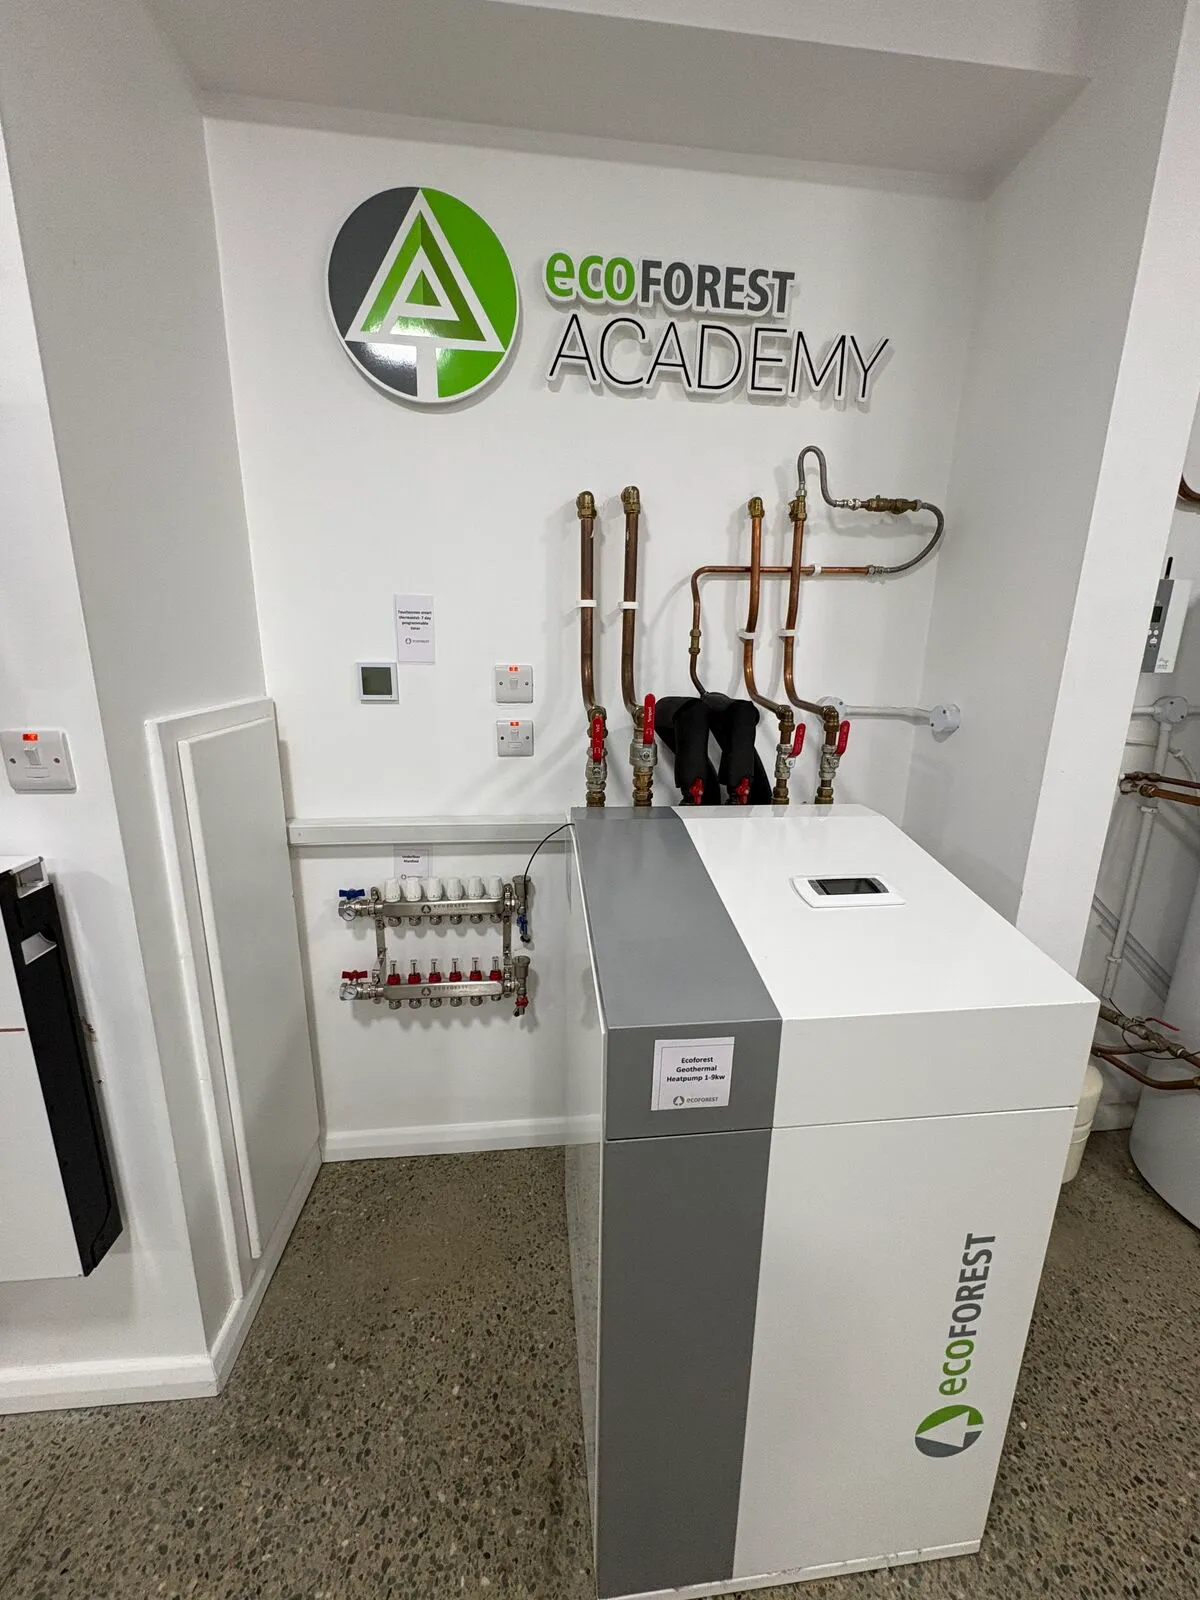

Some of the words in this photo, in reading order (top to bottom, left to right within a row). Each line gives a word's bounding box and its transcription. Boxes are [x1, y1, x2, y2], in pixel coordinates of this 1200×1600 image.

[546, 251, 795, 314] ecoFOREST
[549, 314, 890, 399] ACADEMY
[939, 1233, 996, 1396] ecoFOREST
